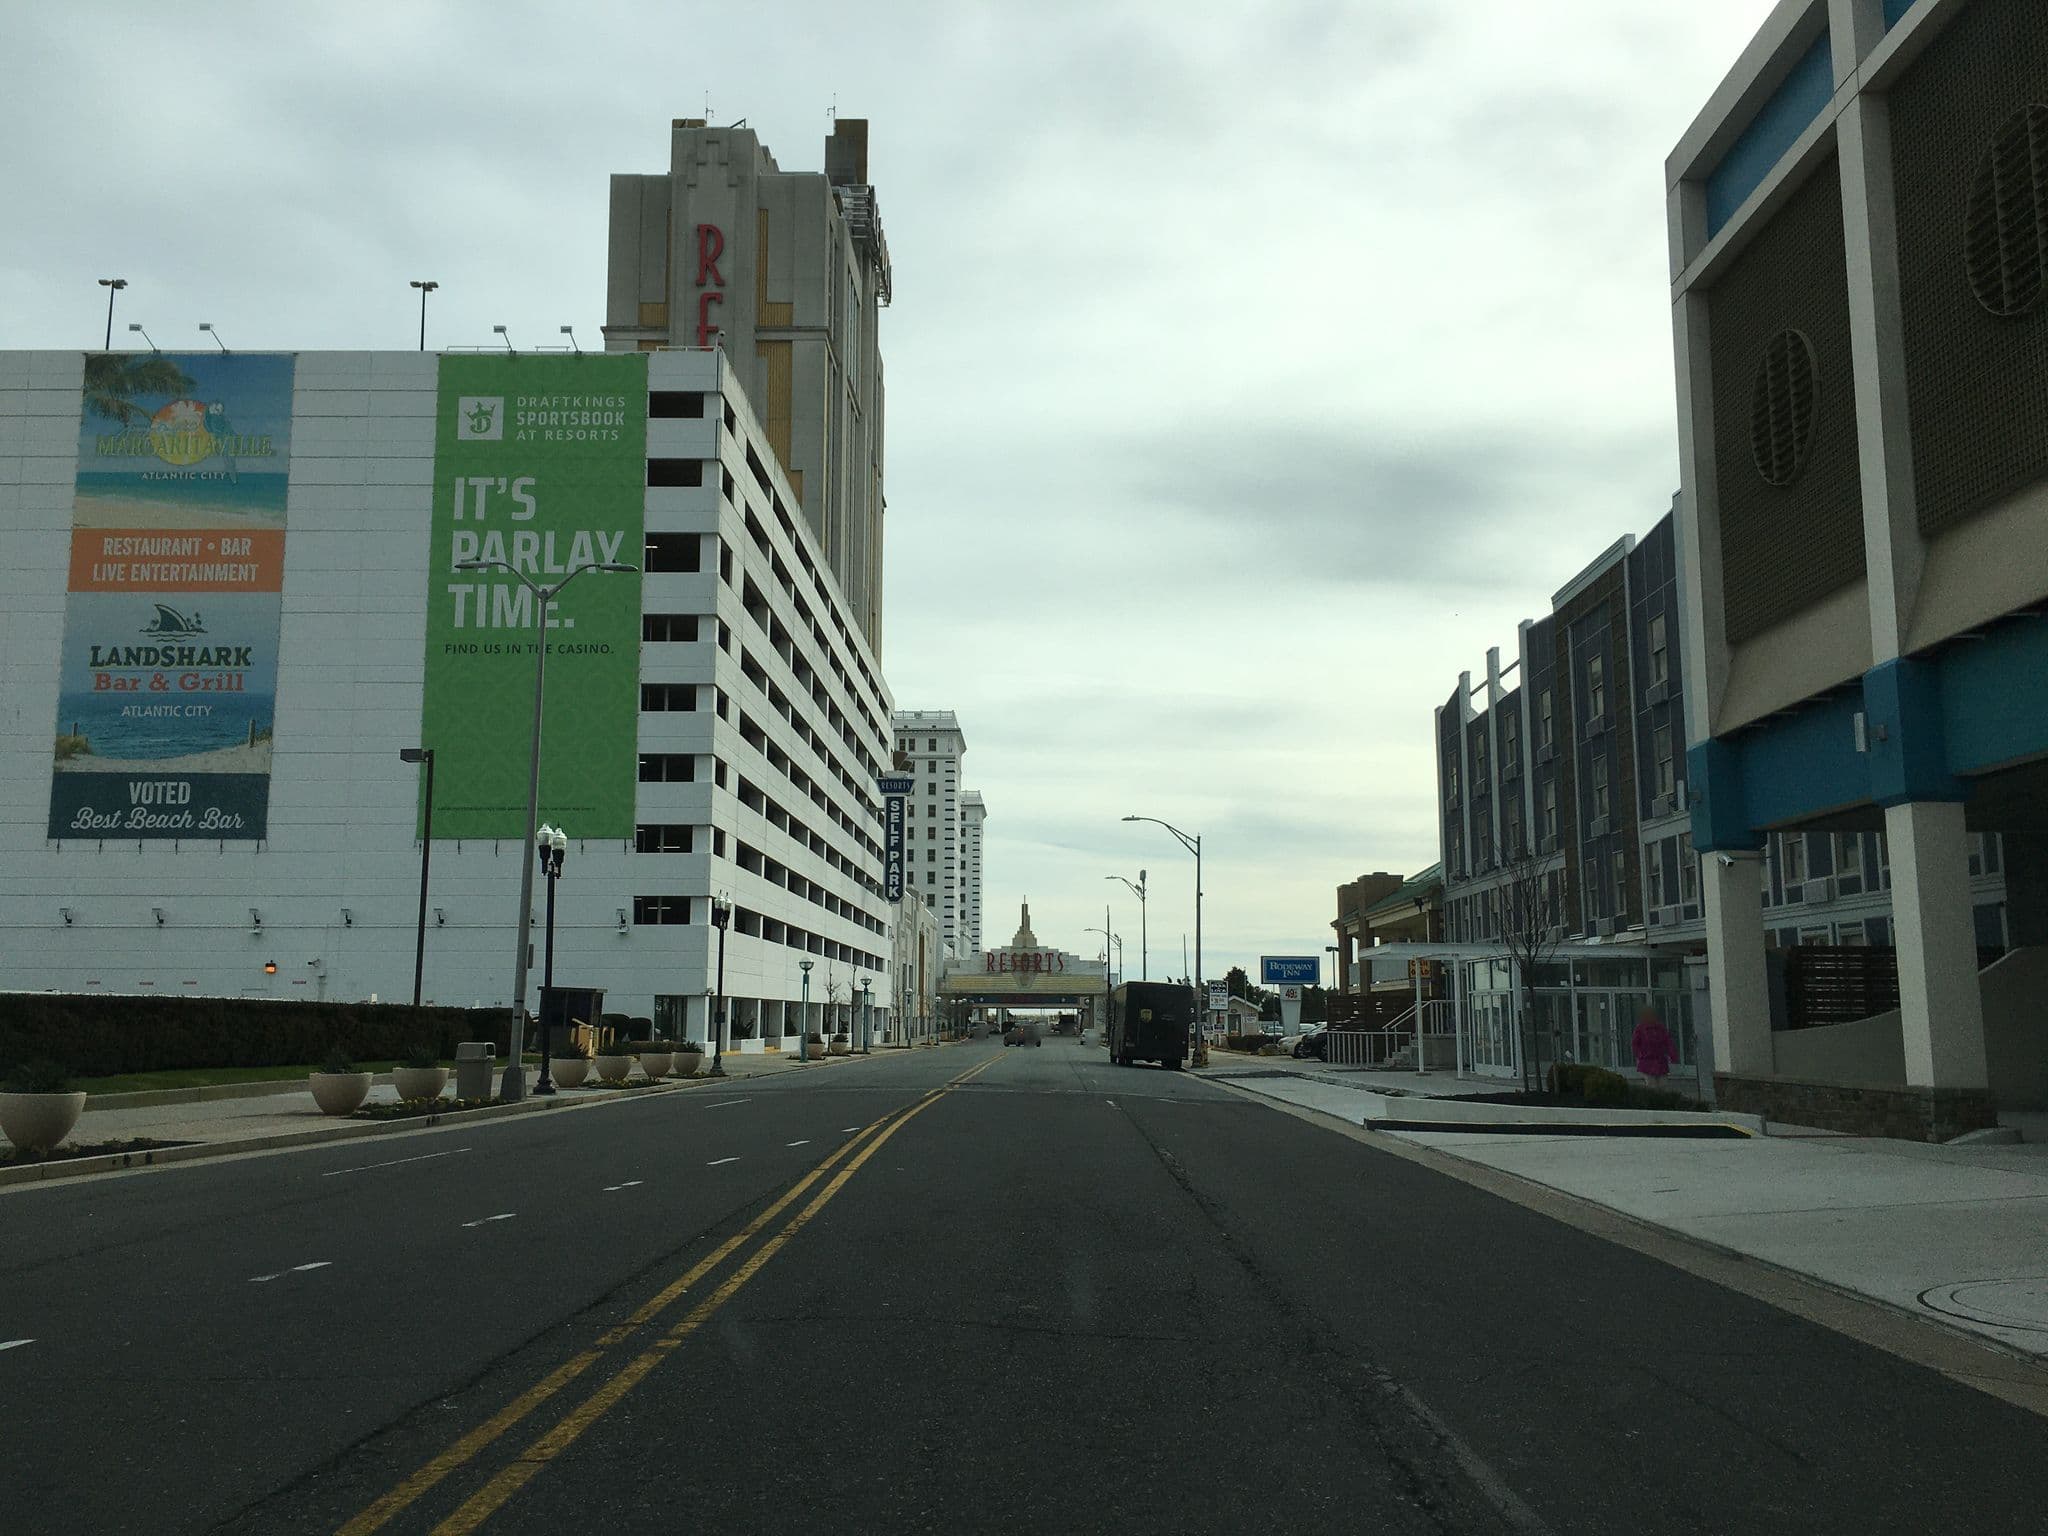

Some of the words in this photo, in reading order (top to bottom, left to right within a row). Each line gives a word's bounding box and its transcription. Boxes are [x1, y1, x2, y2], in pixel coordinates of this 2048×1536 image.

[517, 396, 625, 407] DRAFTKINGS
[516, 412, 625, 426] SPORTSBOOK
[516, 430, 536, 440] AT
[545, 430, 619, 440] RESORTS
[96, 433, 273, 457] MARGARITAVILLE
[141, 472, 195, 480] ATLANTIC
[201, 472, 226, 480] CITY
[454, 477, 536, 520] IT'S
[104, 537, 202, 555] RESTAURANT
[221, 538, 252, 556] BAR
[451, 530, 624, 573] PARLAY
[92, 564, 126, 581] LIVE
[130, 564, 259, 582] ENTERTAINMENT
[90, 646, 252, 667] LANDSHARK
[445, 644, 478, 654] FIND
[484, 644, 501, 654] US
[506, 644, 520, 654] IN
[558, 644, 614, 654] CASINO.
[94, 672, 141, 691] Bar
[149, 672, 170, 691] &
[179, 672, 244, 691] Grill
[122, 706, 180, 716] ATLANTIC
[184, 706, 212, 716] CITY
[129, 782, 191, 804] VOTED
[881, 782, 910, 790] RESORTS
[71, 807, 122, 830] Best
[124, 806, 196, 830] Beach
[199, 807, 245, 830] Bar
[890, 800, 900, 846] SELF
[889, 851, 899, 897] PARK
[987, 952, 1064, 973] RESORTS
[1270, 962, 1312, 970] RODEWAY
[1282, 969, 1300, 978] INN
